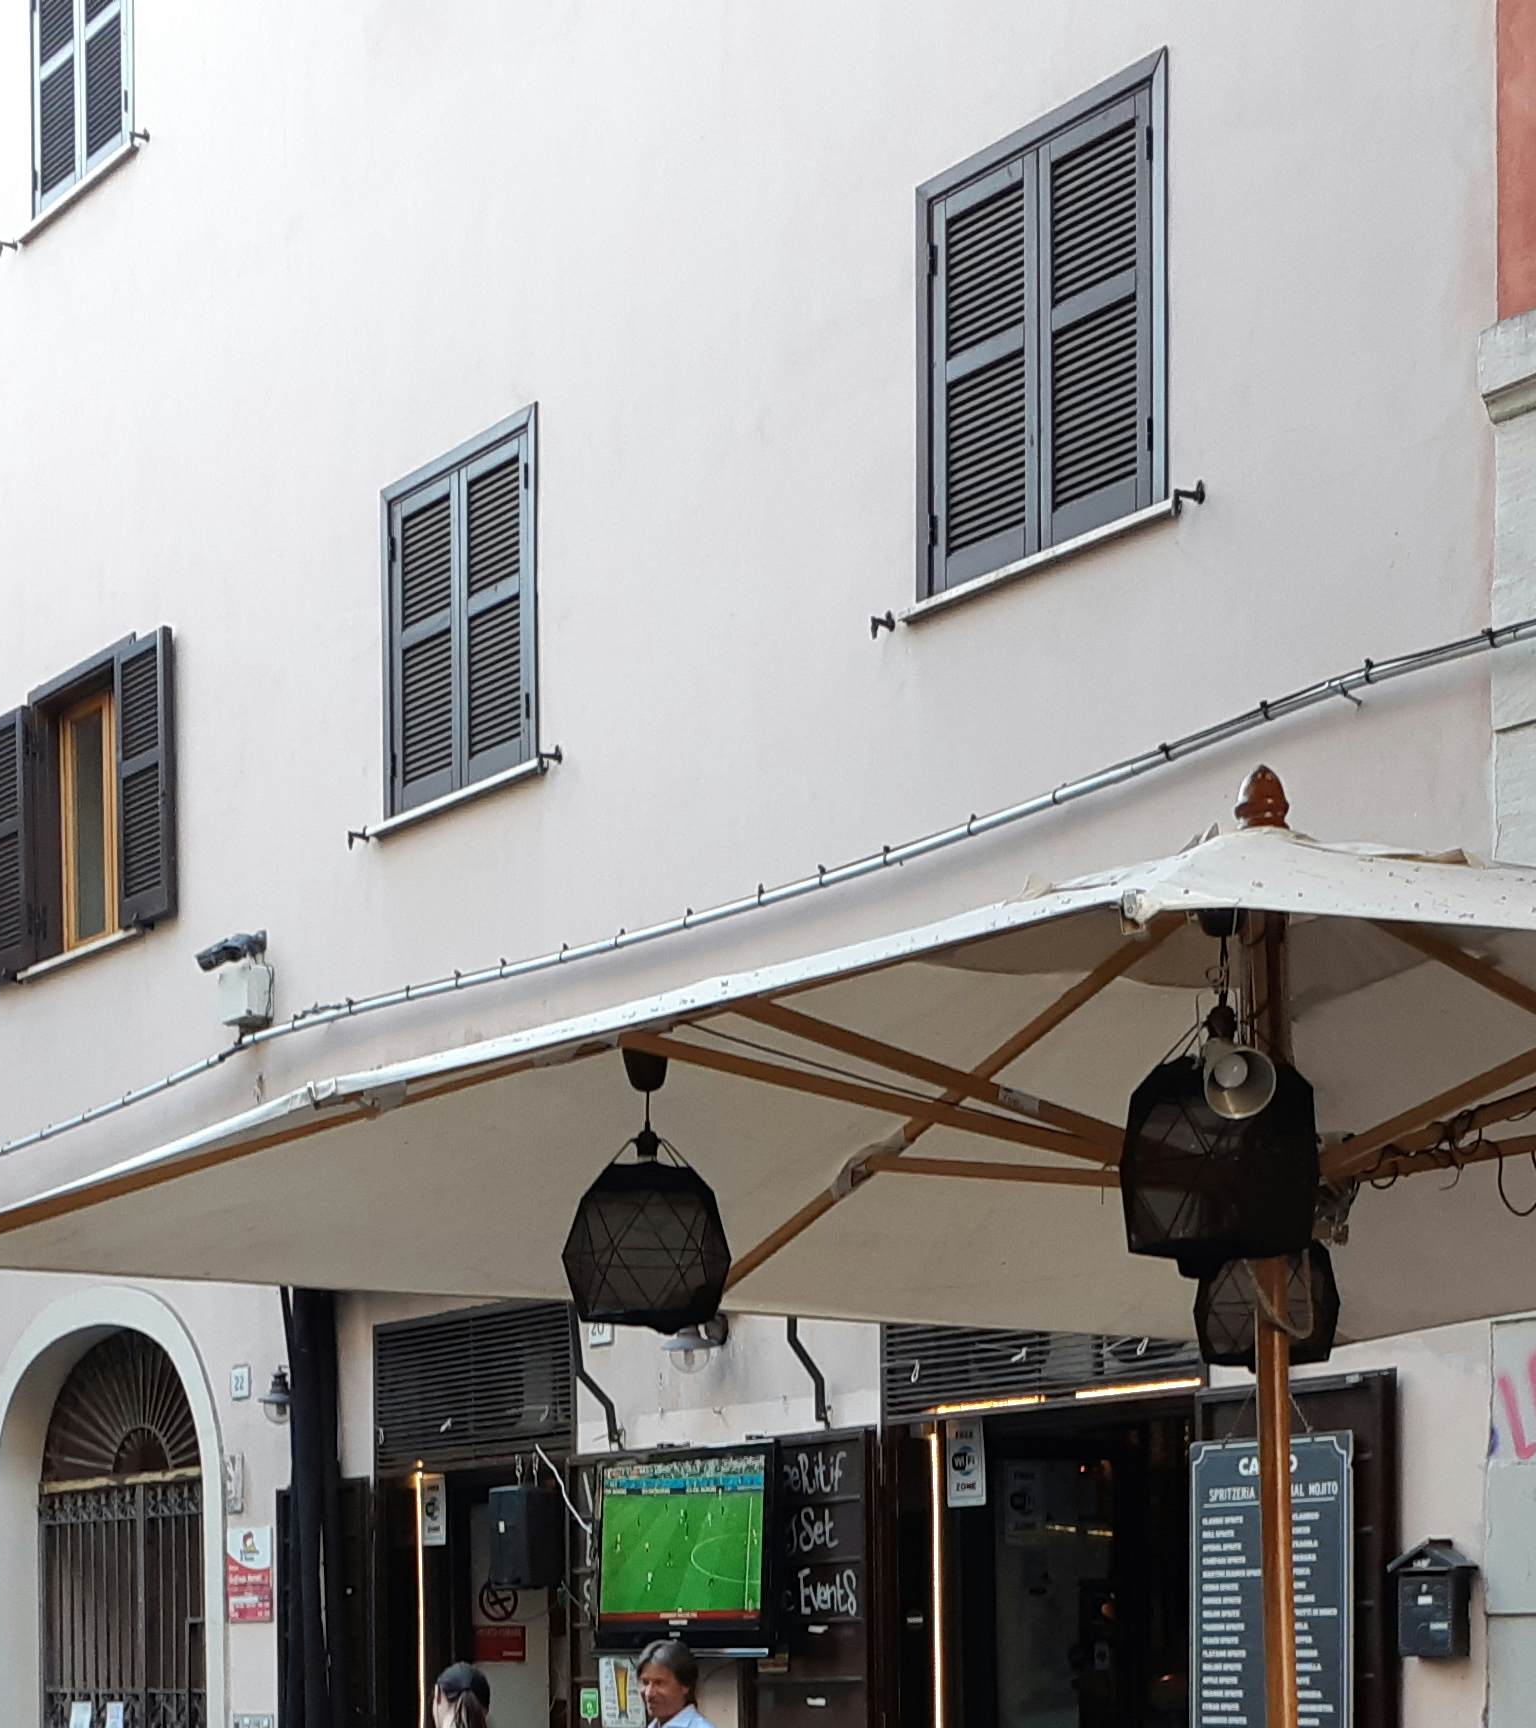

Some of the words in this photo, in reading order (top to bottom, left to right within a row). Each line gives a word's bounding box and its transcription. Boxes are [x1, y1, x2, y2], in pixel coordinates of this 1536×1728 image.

[233, 1375, 245, 1392] 22
[799, 1506, 840, 1551] Set
[798, 1567, 858, 1617] Events
